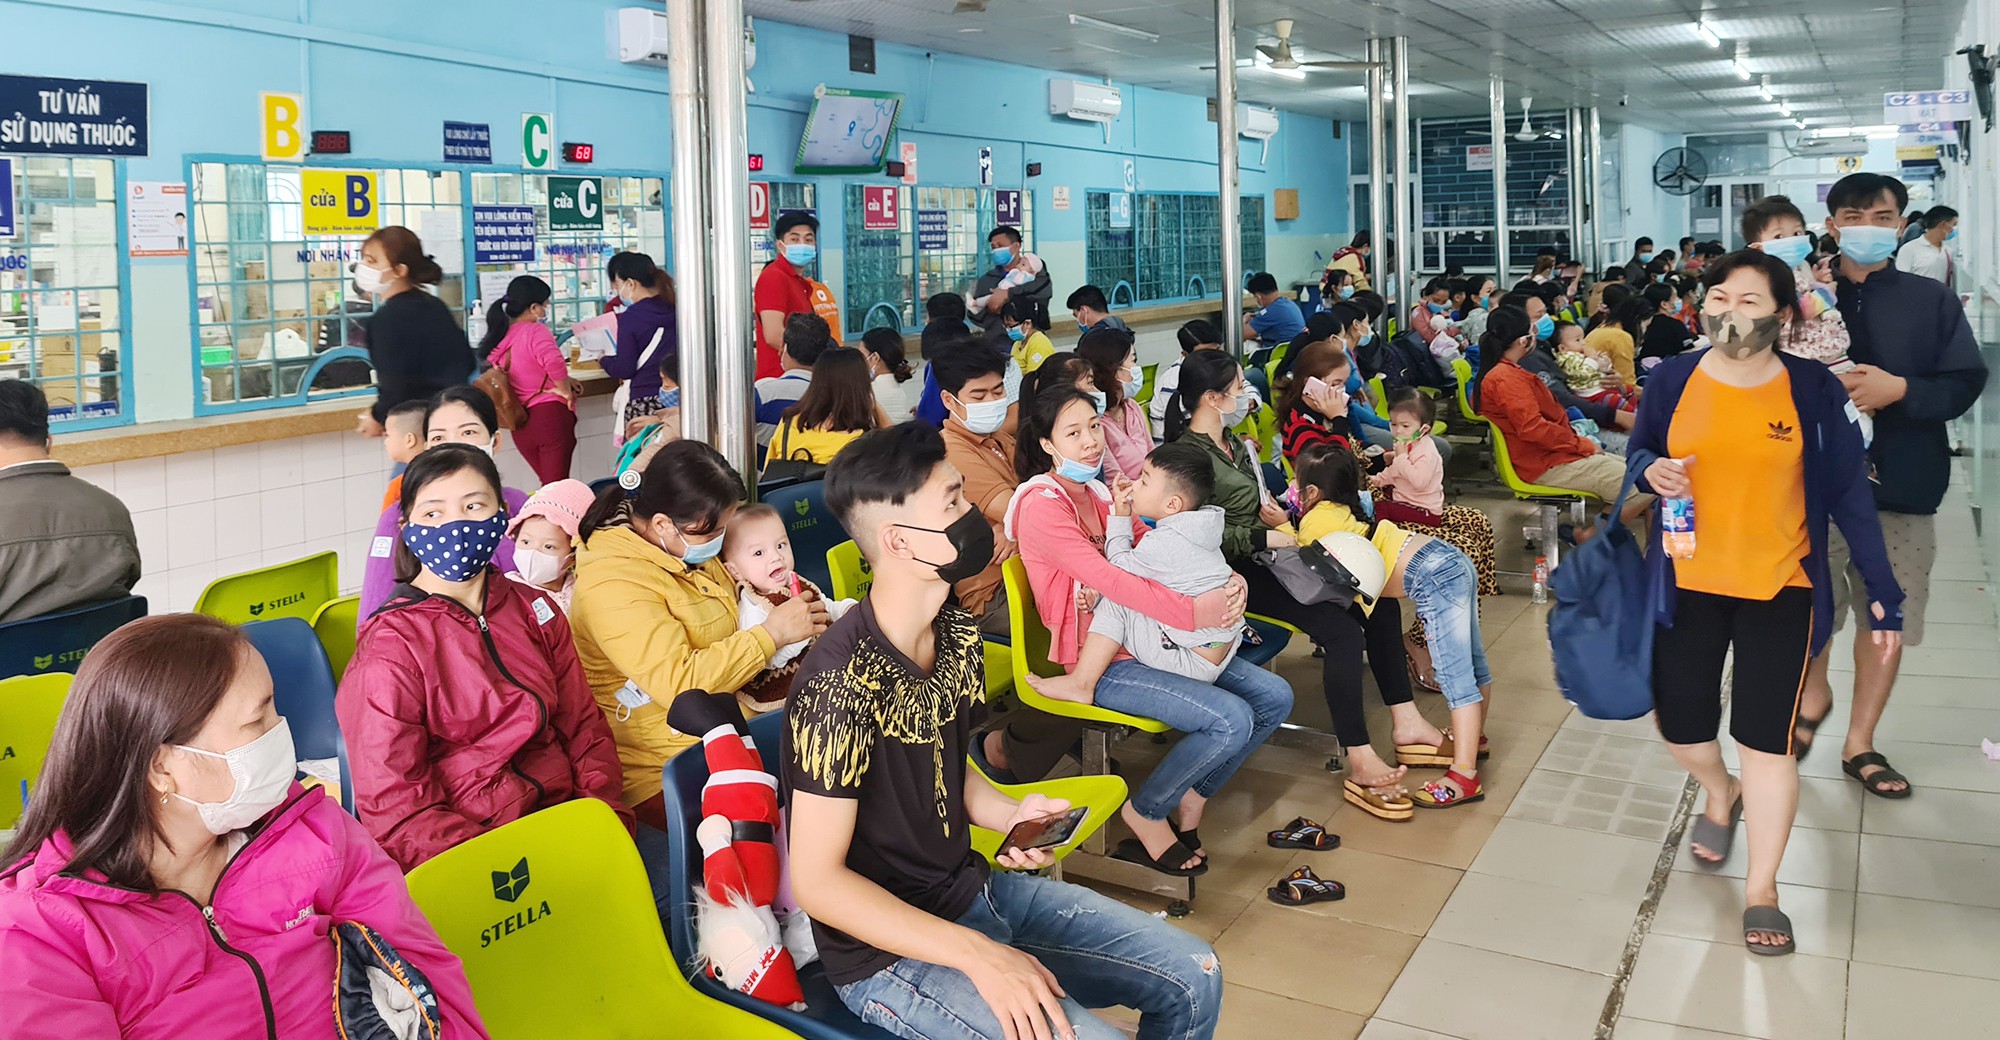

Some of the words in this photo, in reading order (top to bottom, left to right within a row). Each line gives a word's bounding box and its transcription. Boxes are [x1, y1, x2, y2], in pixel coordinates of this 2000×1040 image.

[38, 87, 64, 114] TƯ
[66, 85, 101, 116] VẤN
[1889, 94, 1918, 106] C2
[1937, 92, 1967, 104] C3
[1, 111, 26, 143] SỬ
[29, 120, 78, 148] DỤNG
[80, 116, 136, 147] THUỐC
[265, 95, 300, 158] B
[524, 115, 548, 167] C
[575, 146, 591, 159] 68
[749, 156, 762, 169] 61
[310, 187, 337, 207] cửa
[346, 174, 371, 218] B
[553, 191, 574, 209] cửa
[578, 179, 598, 219] C
[750, 184, 766, 218] D
[883, 188, 894, 218] E
[1009, 192, 1018, 218] F
[1120, 195, 1128, 219] G
[792, 517, 817, 531] STELLA
[269, 591, 305, 610] STELLA
[58, 649, 88, 664] STE
[481, 900, 551, 948] STELLA
